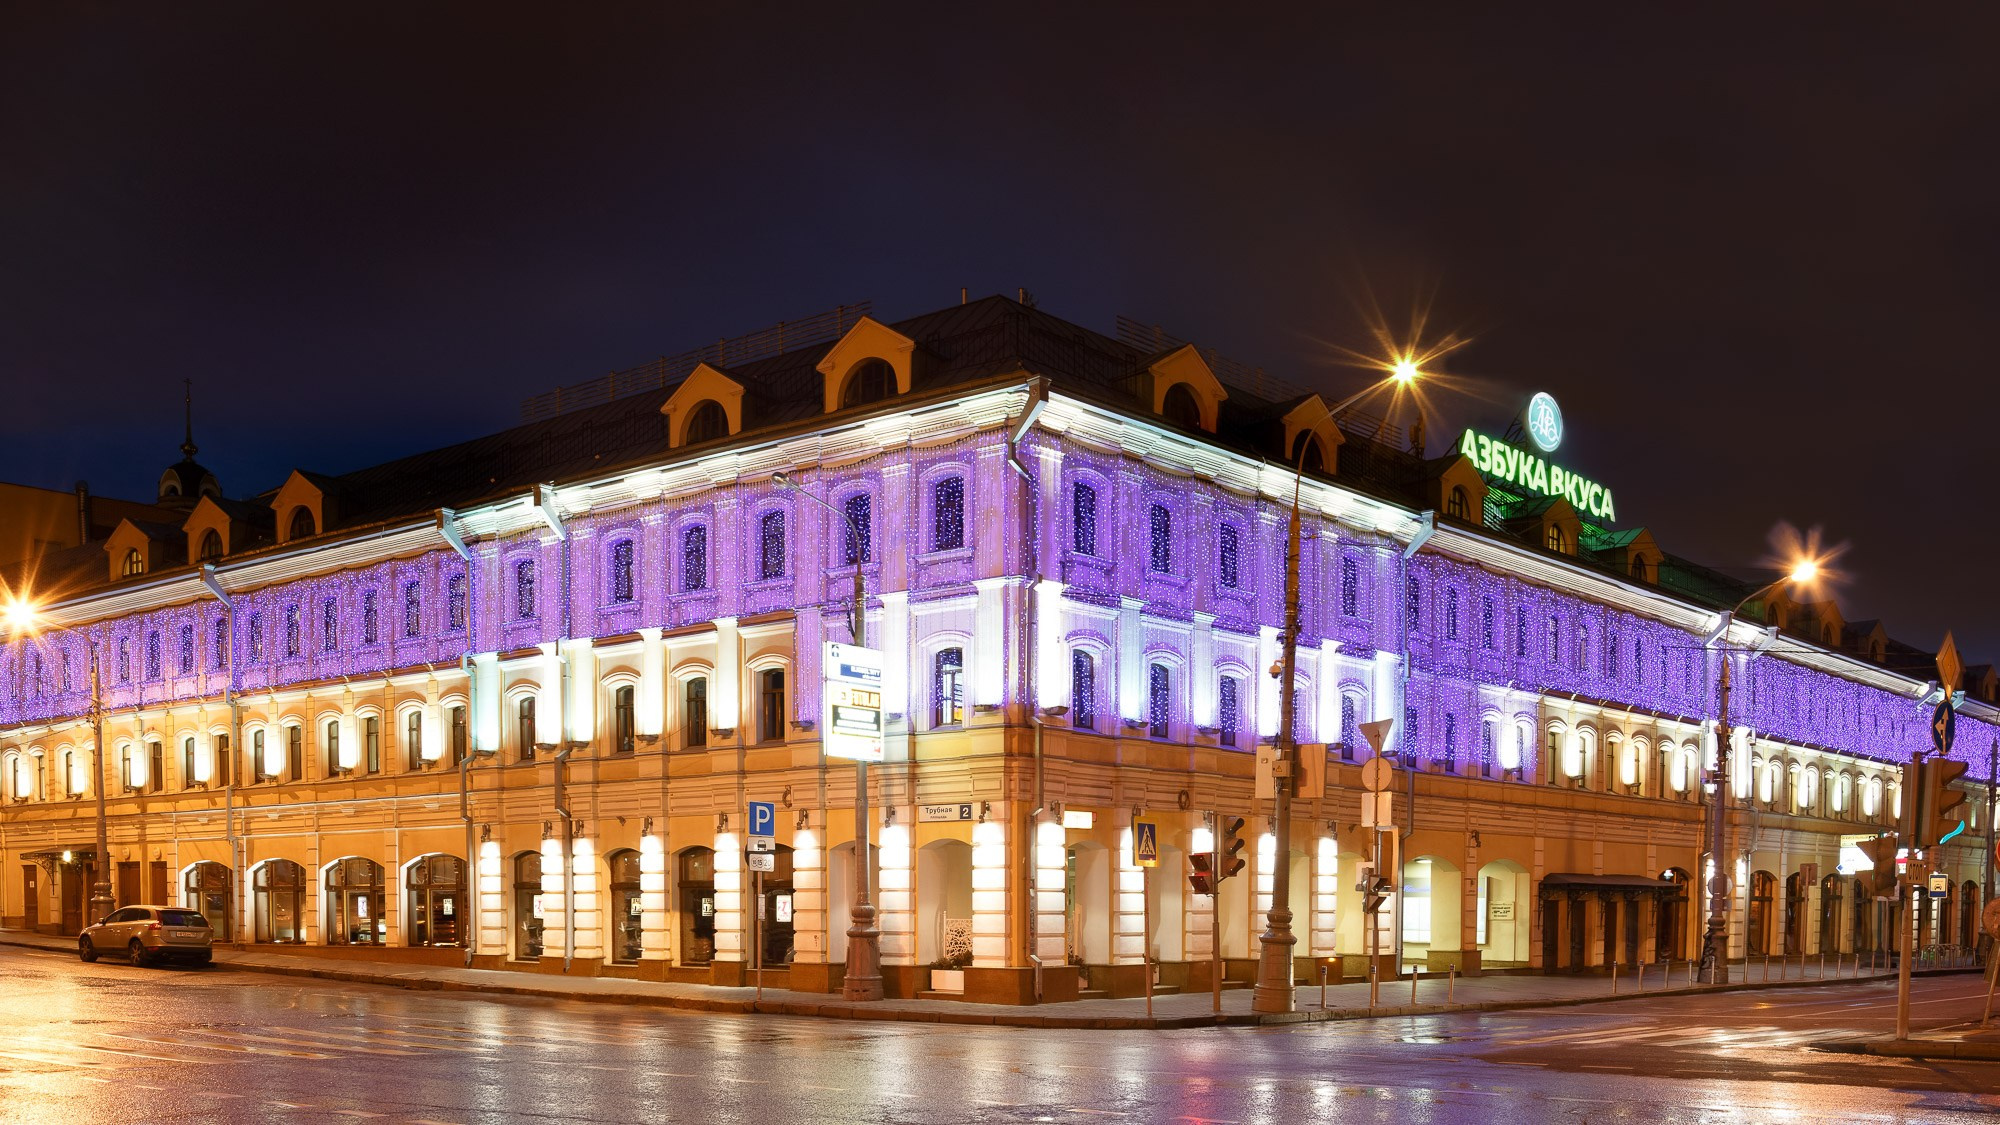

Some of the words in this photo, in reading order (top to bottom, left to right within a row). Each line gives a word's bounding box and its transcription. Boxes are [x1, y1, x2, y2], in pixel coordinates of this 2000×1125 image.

[1461, 428, 1549, 495] АЗБУКА
[1550, 465, 1616, 523] ВКУСА
[756, 805, 770, 832] P
[925, 806, 953, 815] Трубная
[962, 807, 969, 817] 2
